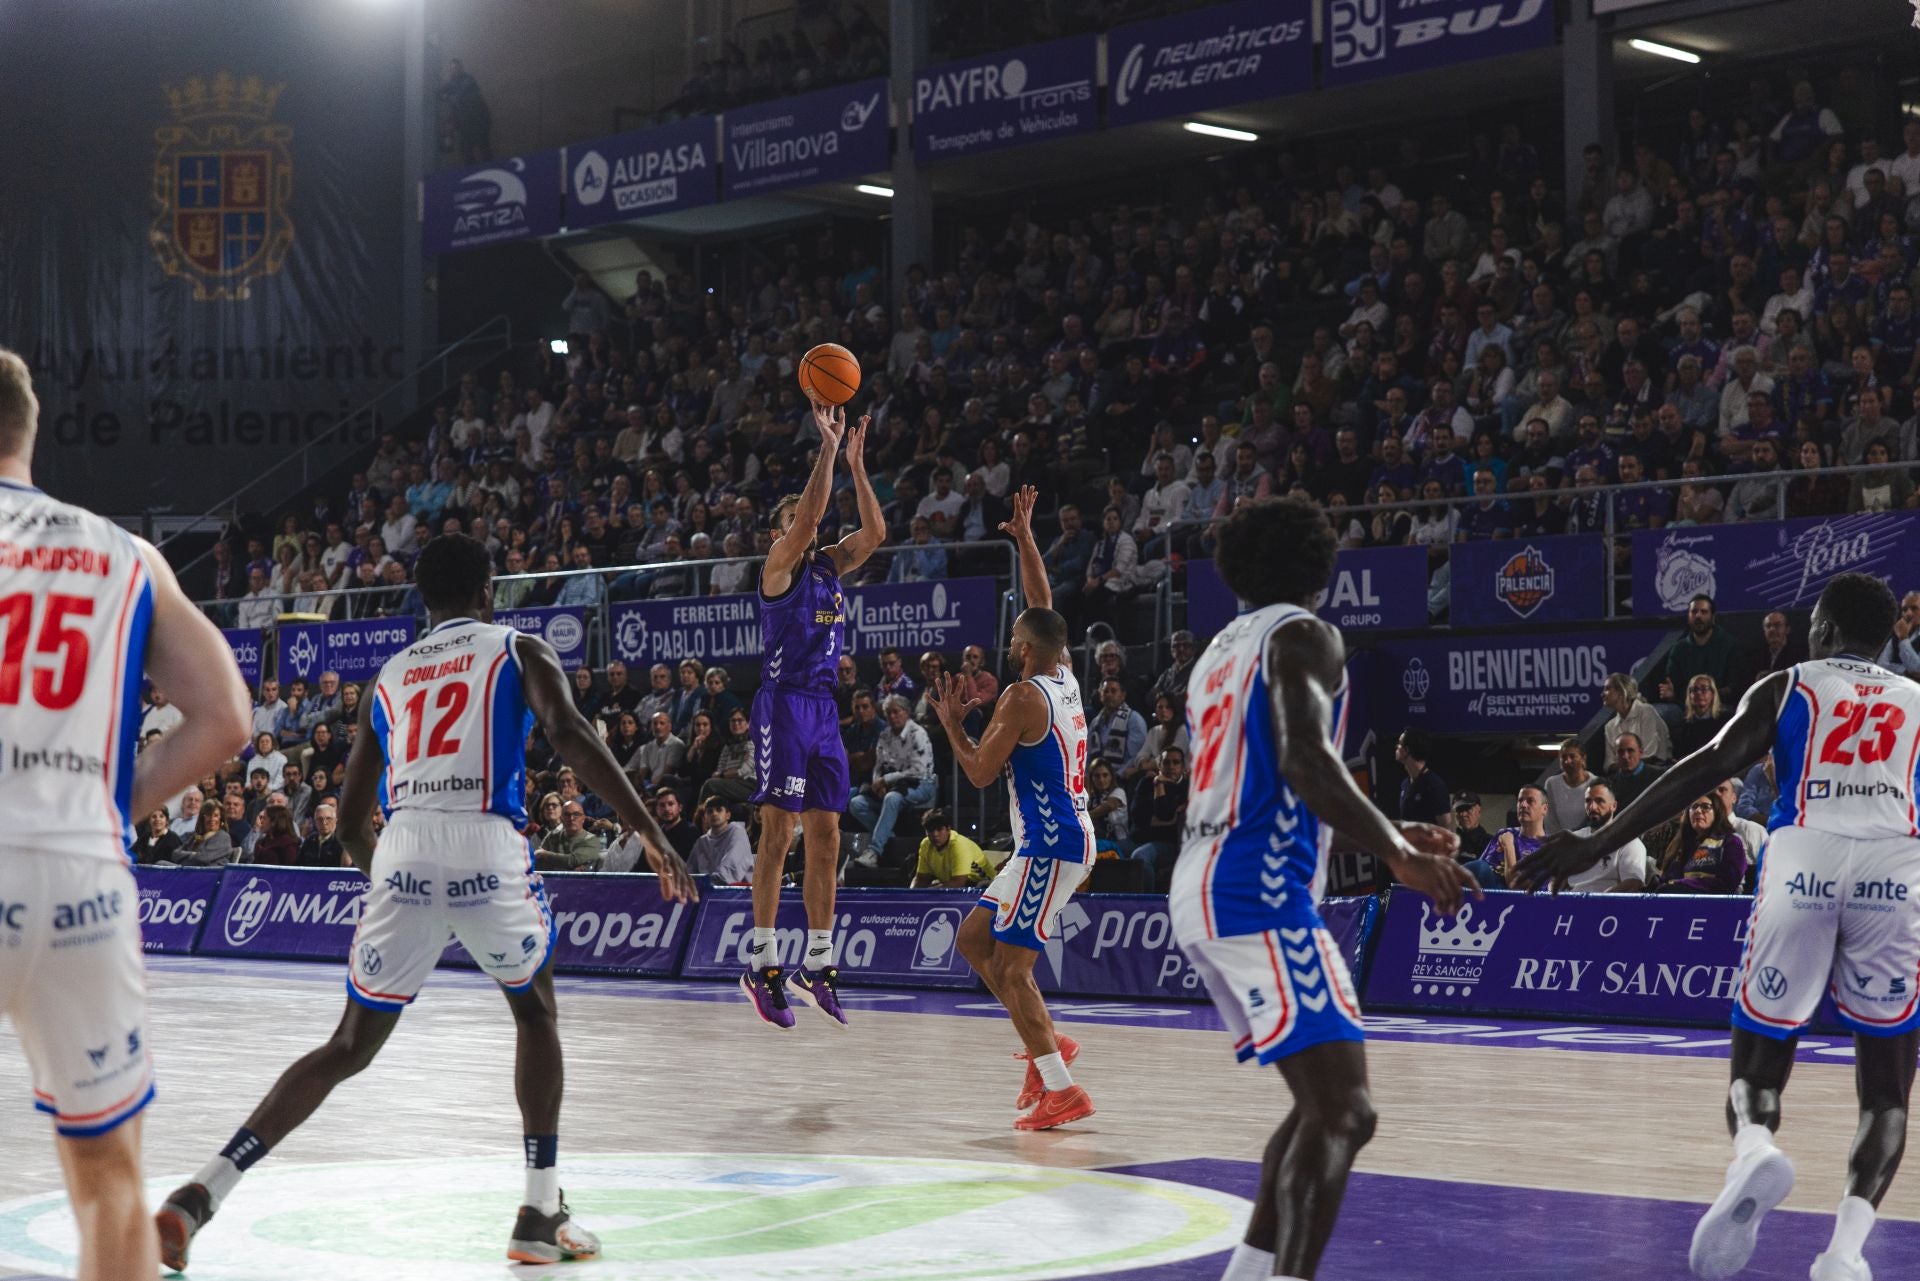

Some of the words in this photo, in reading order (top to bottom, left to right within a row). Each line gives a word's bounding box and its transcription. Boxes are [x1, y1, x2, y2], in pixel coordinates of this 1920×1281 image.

[1152, 19, 1305, 67] NEUMÁTICOS
[1143, 54, 1262, 95] PALENCIA
[1019, 85, 1092, 111] Trans
[928, 128, 993, 151] Transporte
[996, 120, 1015, 139] de
[731, 130, 839, 171] Villanova
[611, 142, 707, 186] AUPASA
[55, 400, 121, 446] de
[148, 400, 384, 446] Palencia
[1499, 574, 1551, 593] PALENCIA
[672, 598, 755, 625] FERRETERÍA
[1341, 613, 1381, 626] GRUPO
[327, 631, 360, 648] sara
[364, 628, 407, 645] varas
[652, 628, 705, 660] PABLO
[865, 624, 946, 650] muiños
[0, 592, 95, 711] 15
[402, 652, 476, 687] COULIBALY
[1448, 645, 1608, 692] BIENVENIDOS
[1467, 692, 1486, 715] al
[1486, 693, 1590, 706] SENTIMIENTO
[1487, 705, 1576, 717] PALENTINO.
[404, 681, 469, 763] 12
[1820, 700, 1907, 766] 23
[412, 774, 485, 795] Inurban
[328, 881, 373, 892] GRUPO
[447, 872, 499, 897] ante
[1853, 877, 1908, 901] ante
[1792, 899, 1824, 911] Sports
[860, 912, 920, 925] autoservicios
[884, 925, 917, 937] ahorro
[1552, 914, 1747, 942] HOTEL
[1412, 964, 1433, 975] REY
[1434, 965, 1483, 978] SANCHO
[1417, 954, 1486, 966] Hotel
[1510, 958, 1593, 992] REY
